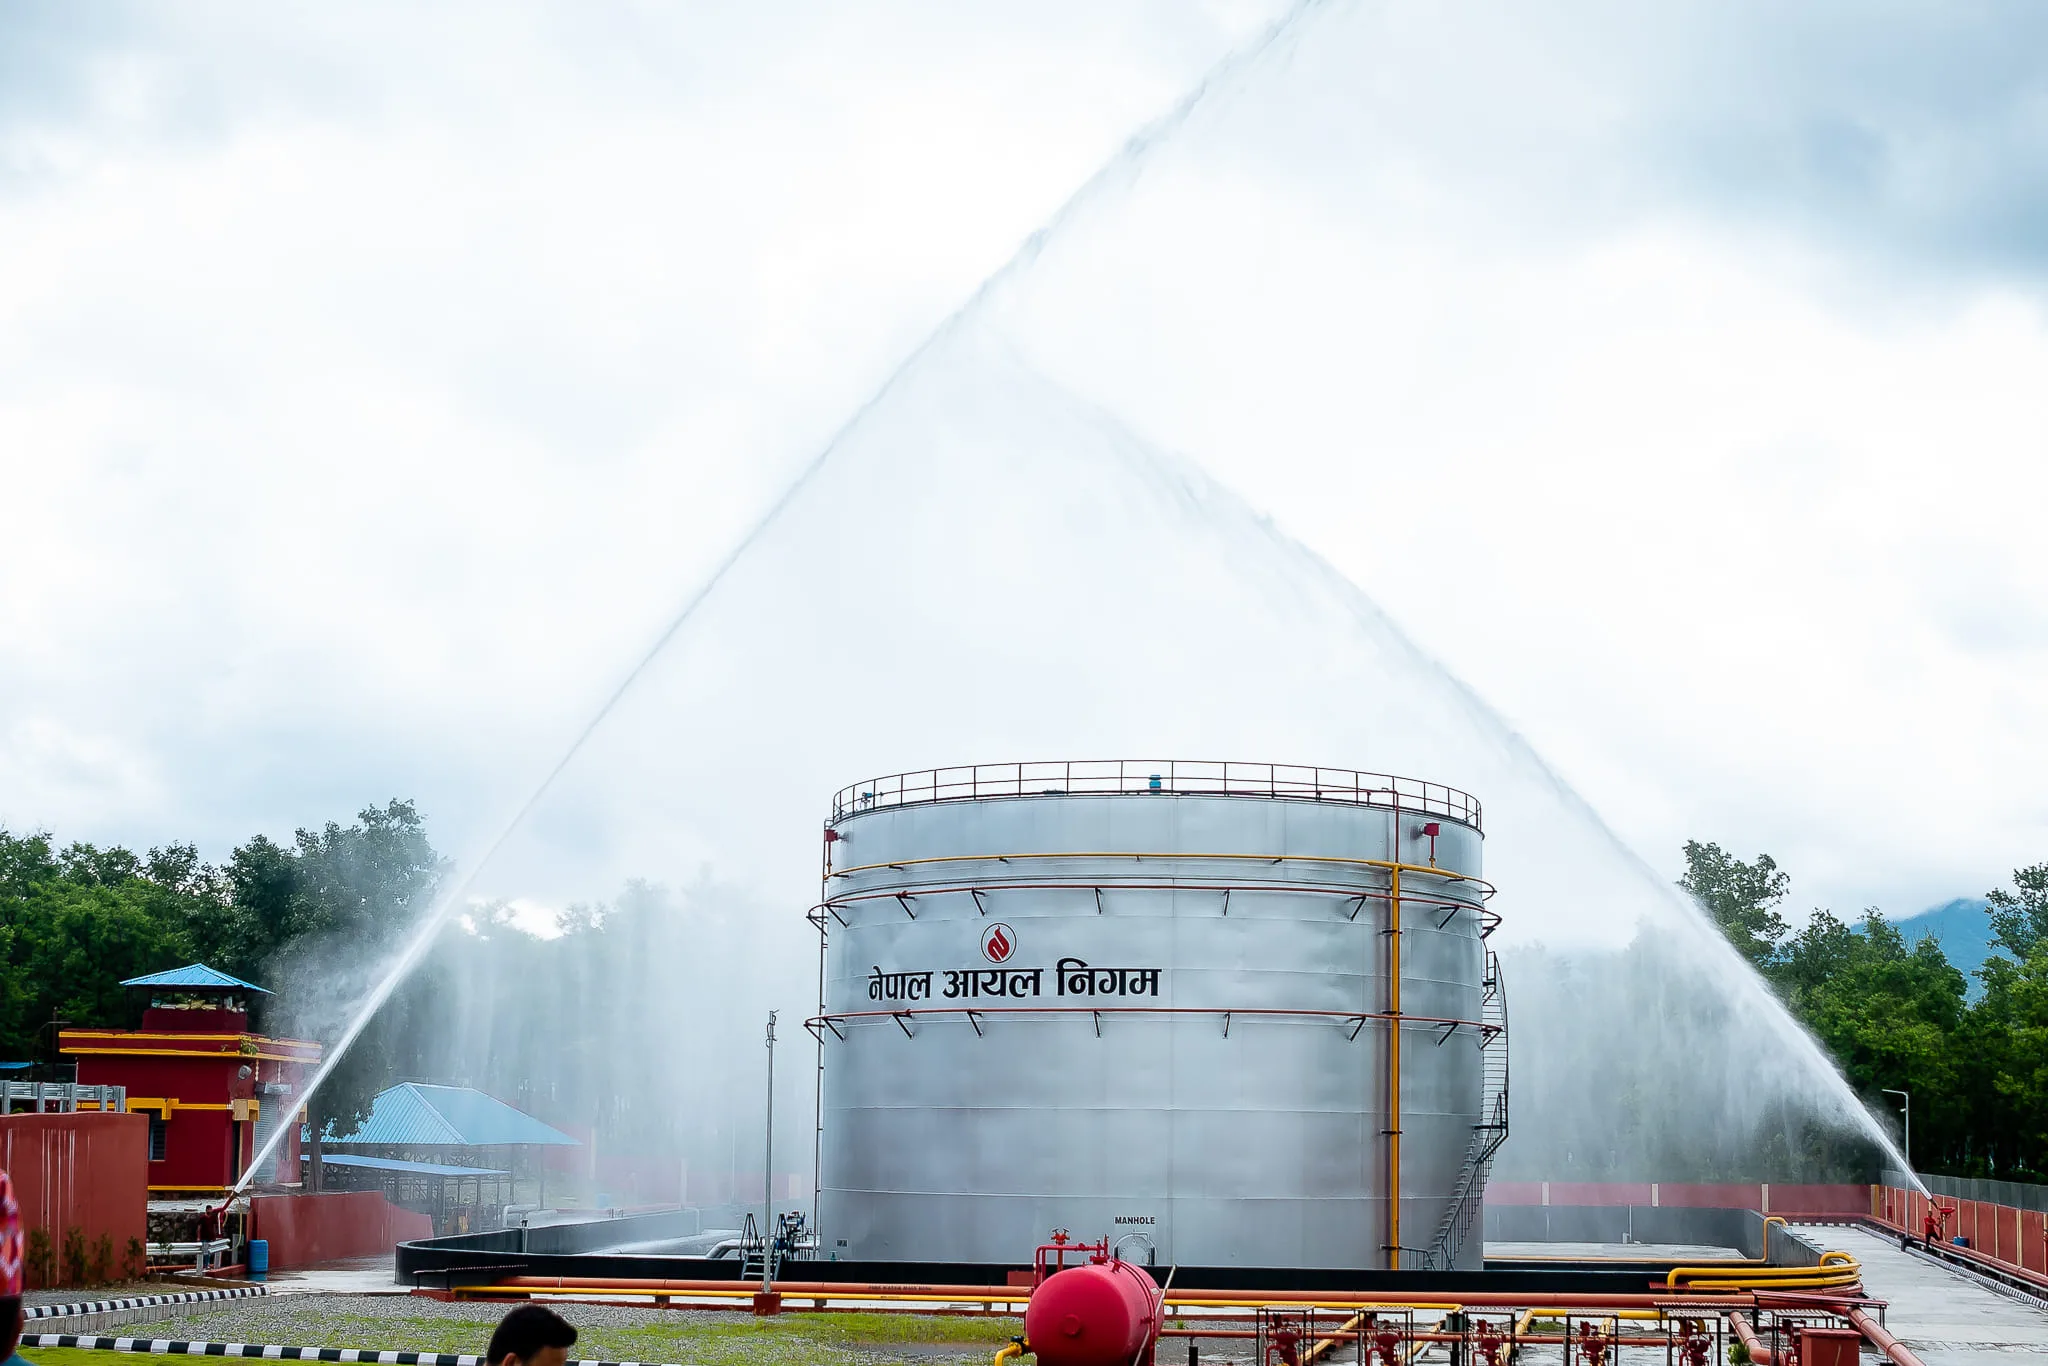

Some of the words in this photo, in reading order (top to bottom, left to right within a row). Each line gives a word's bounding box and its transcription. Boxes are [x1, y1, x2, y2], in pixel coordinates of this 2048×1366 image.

[868, 965, 934, 1001] नेपाल
[942, 968, 1045, 998] आयल
[1056, 957, 1163, 997] निगम
[1114, 1216, 1156, 1225] MANHOLE
